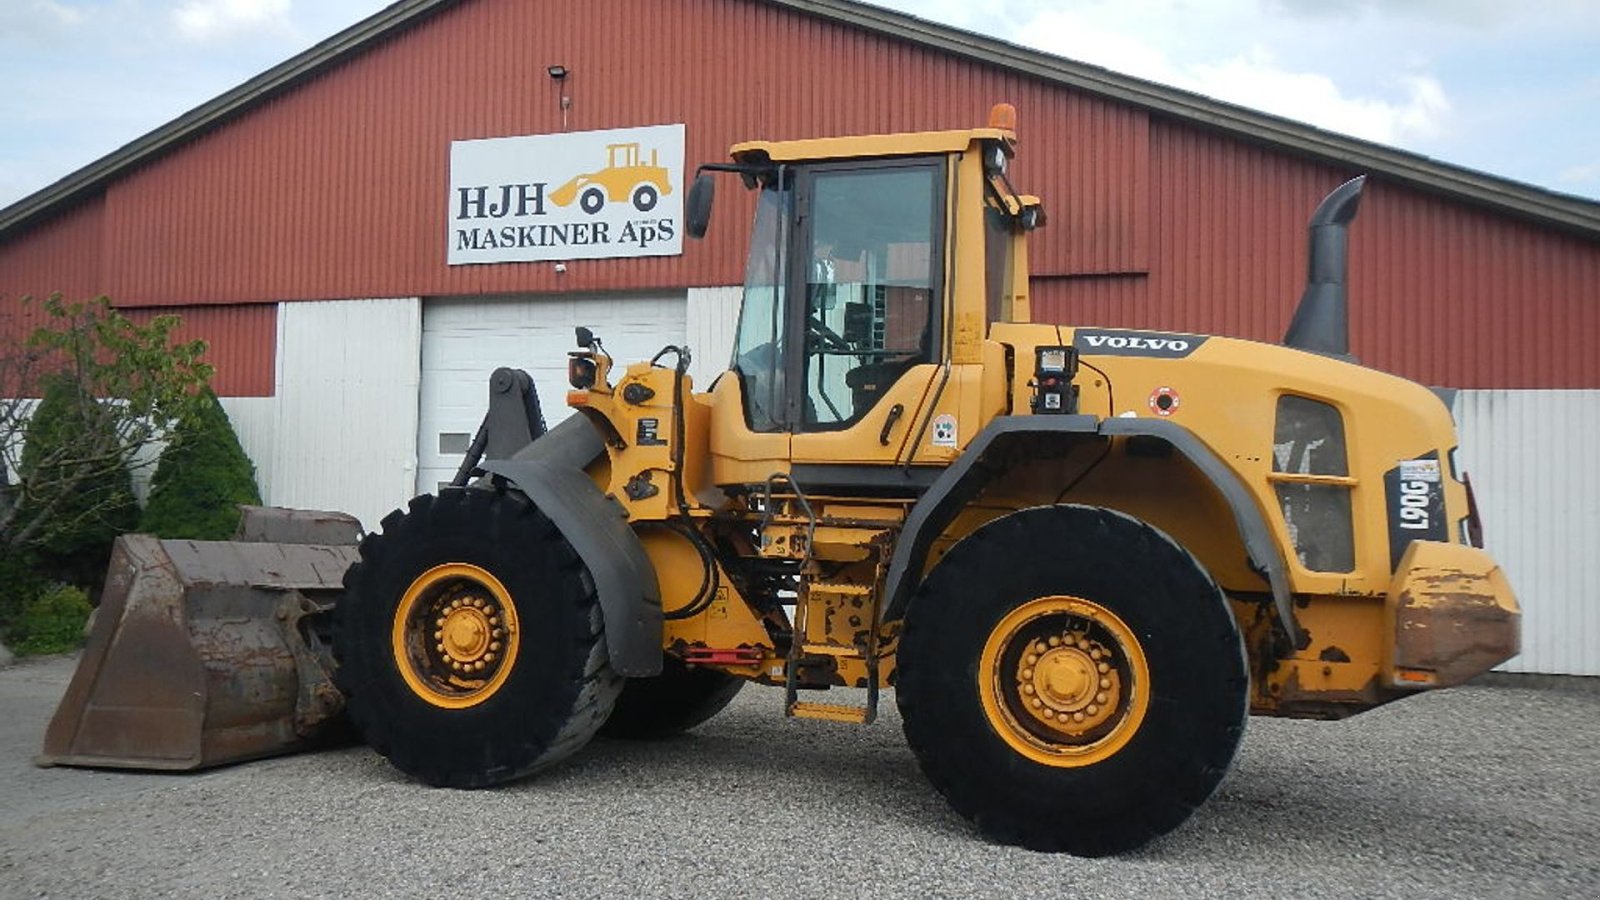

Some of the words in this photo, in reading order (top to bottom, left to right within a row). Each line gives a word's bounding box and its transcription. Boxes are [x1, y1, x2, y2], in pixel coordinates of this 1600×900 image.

[457, 183, 547, 220] HJH
[457, 222, 611, 251] MASKINER
[618, 219, 674, 248] ApS
[1083, 335, 1189, 352] VOLVO
[1400, 481, 1429, 530] L90G
